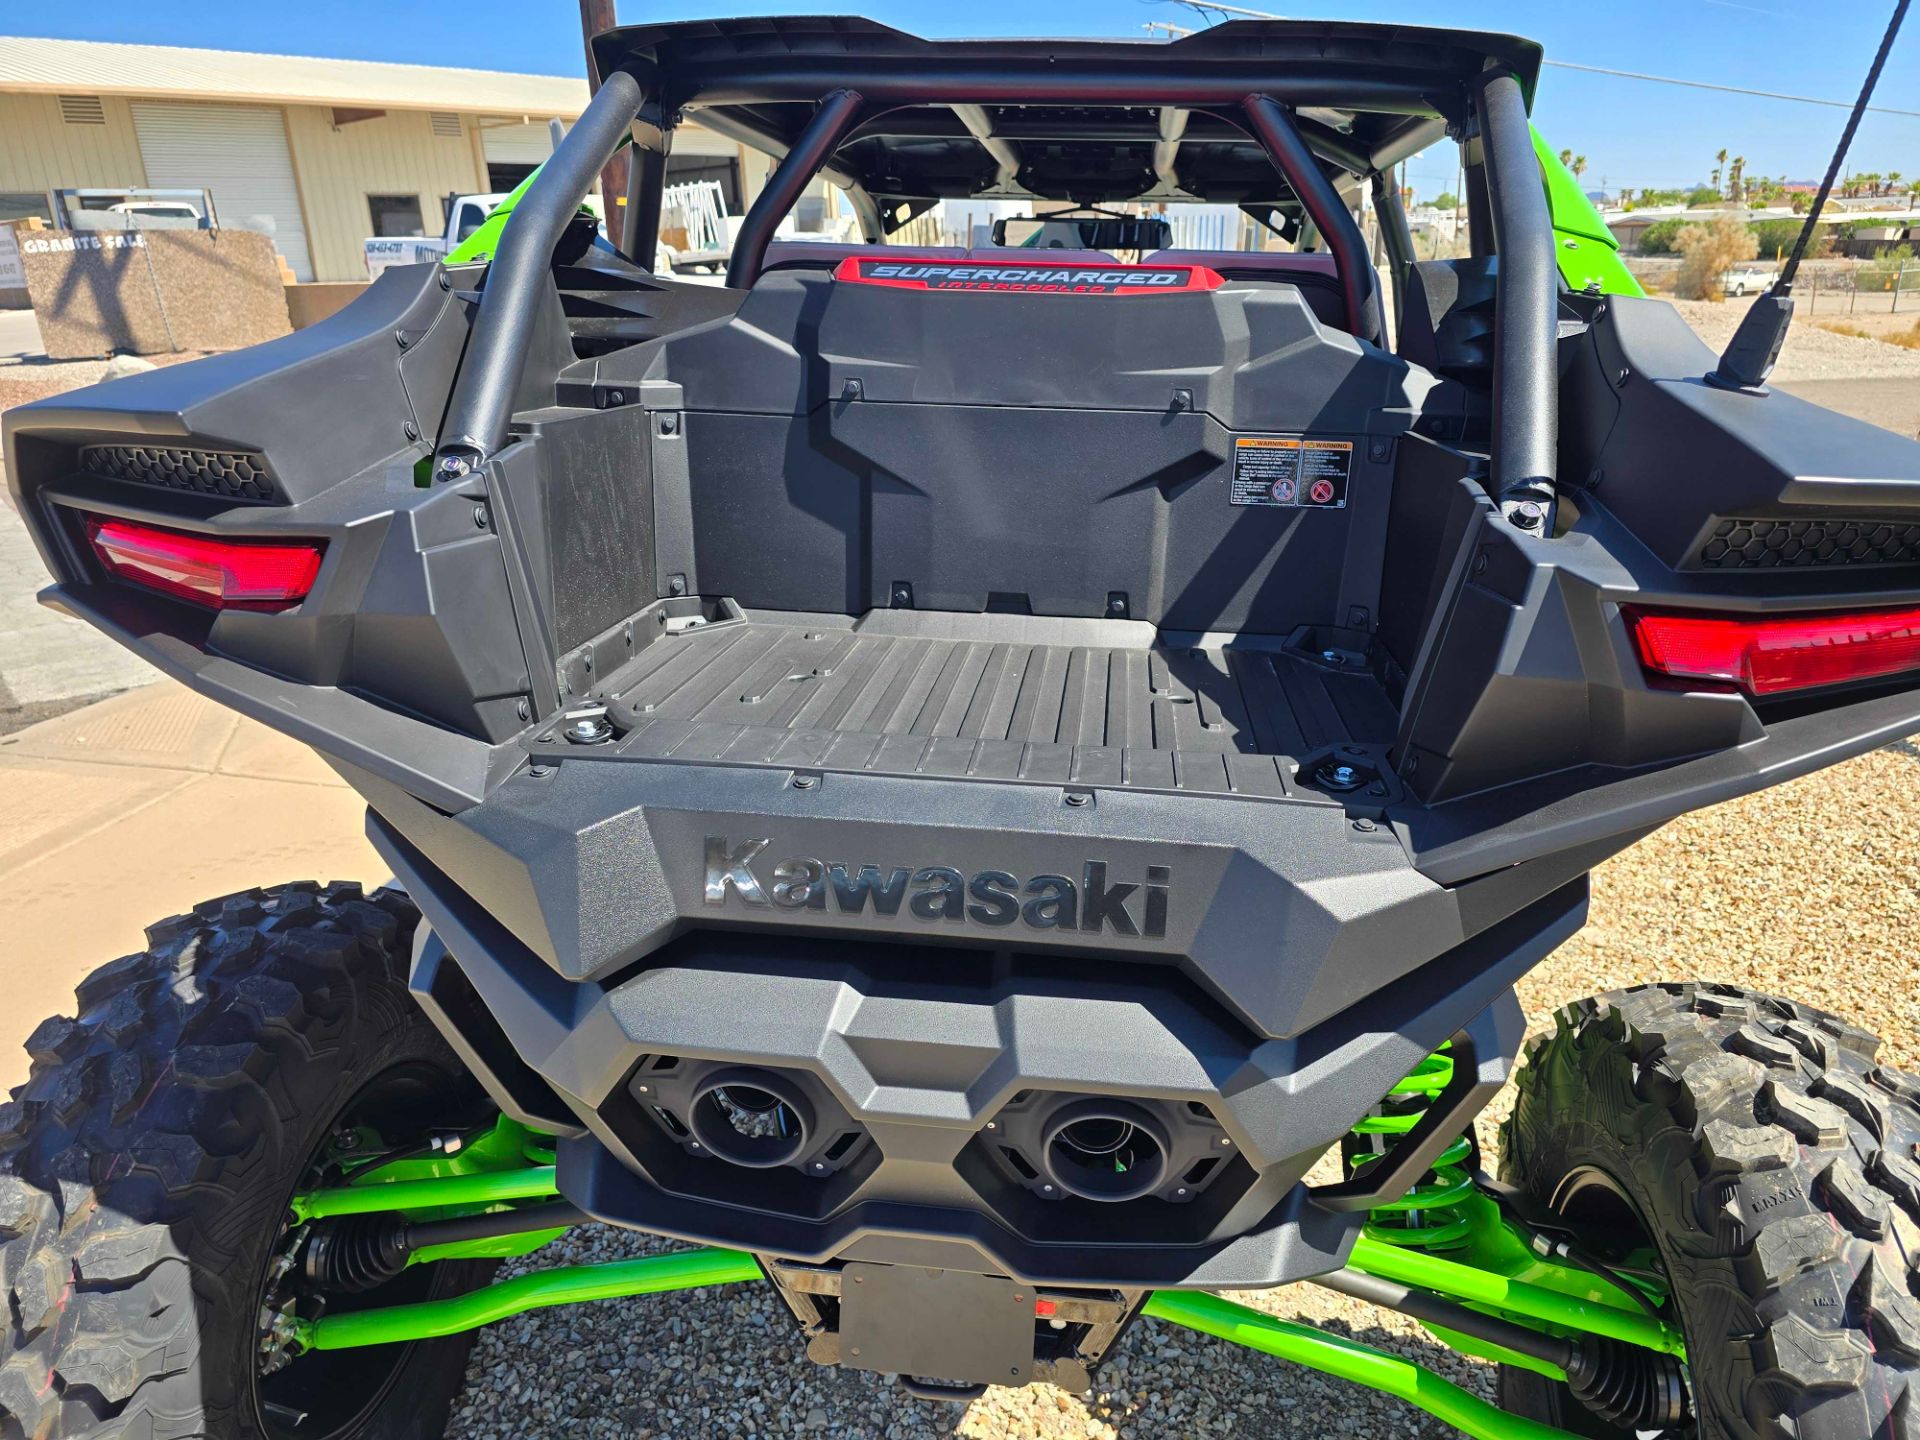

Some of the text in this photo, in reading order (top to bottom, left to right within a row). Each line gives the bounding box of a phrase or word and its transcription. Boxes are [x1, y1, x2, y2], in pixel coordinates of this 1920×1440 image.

[23, 236, 101, 254] GRANITE
[104, 234, 147, 250] SALE
[869, 265, 1176, 286] SUPERCHARGED
[938, 281, 1106, 293] INTERCOOLED
[702, 834, 1172, 938] Kawasaki
[1752, 1186, 1803, 1213] MAXXIS
